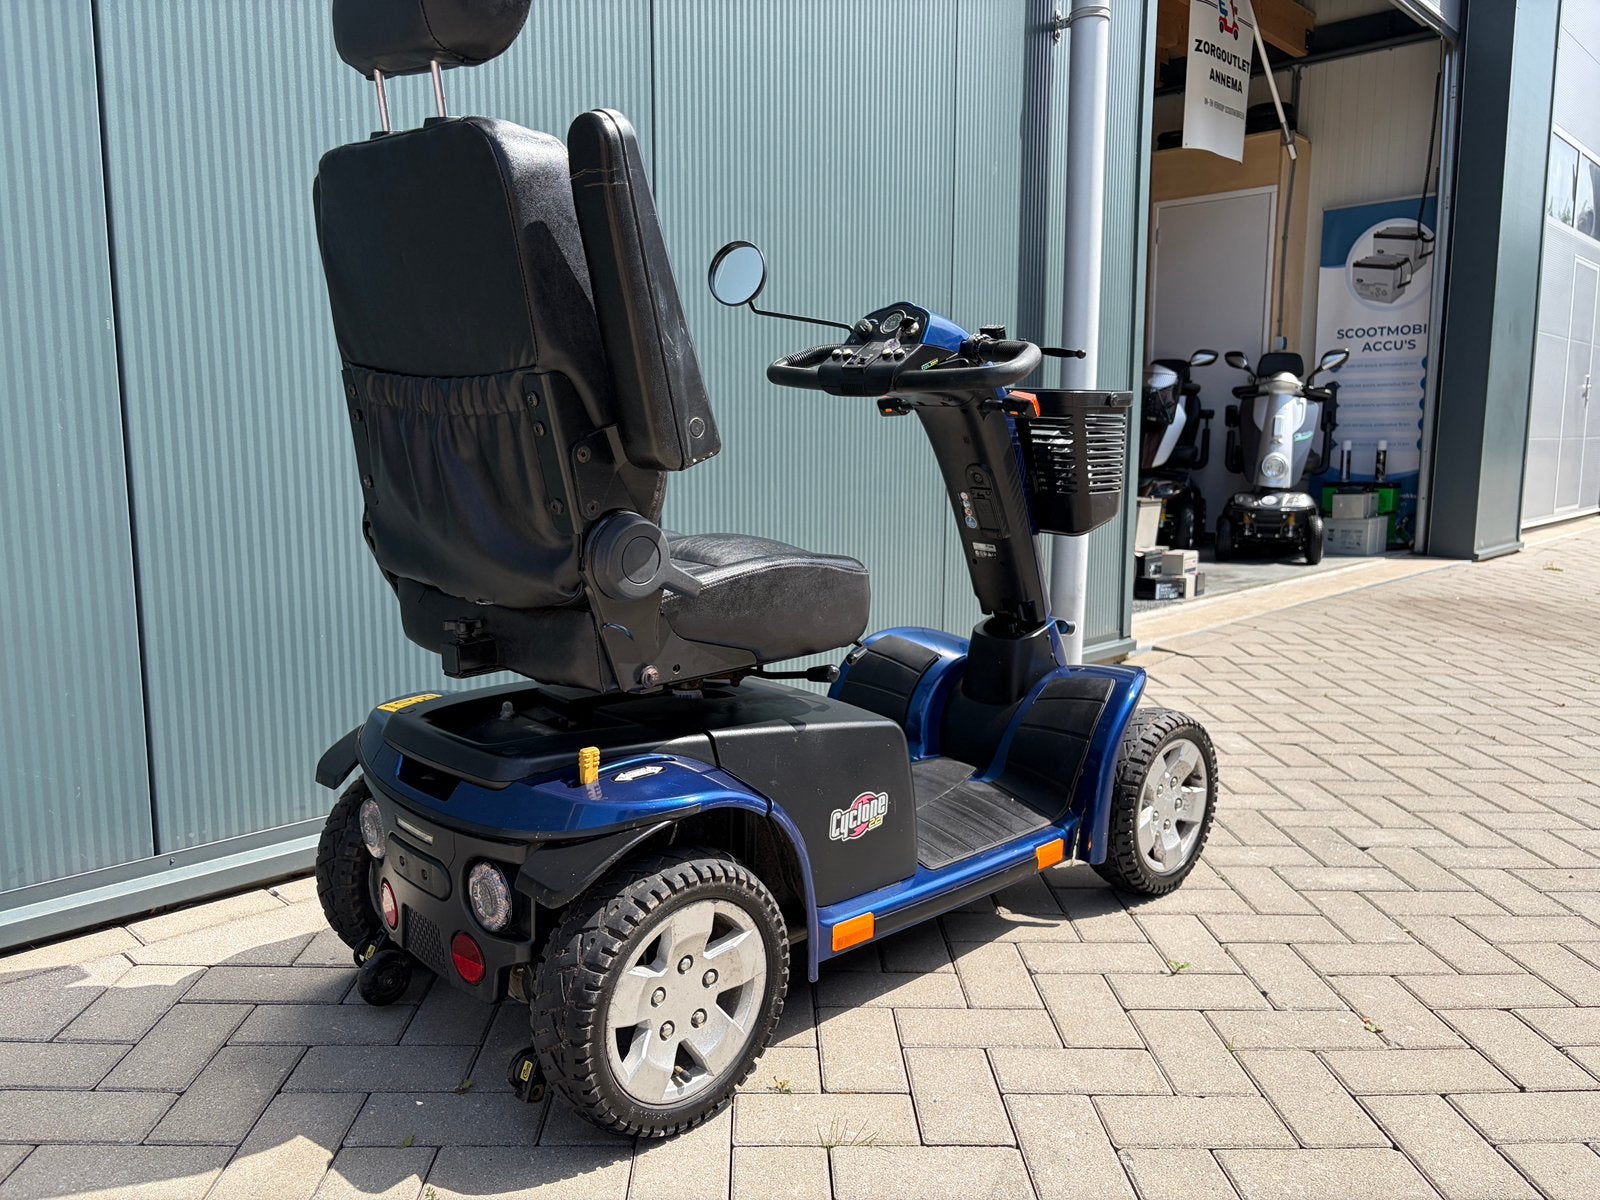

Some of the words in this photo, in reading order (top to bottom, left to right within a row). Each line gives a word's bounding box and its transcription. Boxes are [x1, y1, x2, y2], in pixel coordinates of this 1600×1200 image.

[1194, 38, 1250, 74] ZORGOUTLET
[1209, 68, 1243, 94] ANNEMA
[1361, 339, 1417, 353] ACCU'S
[831, 794, 887, 838] Cyclone
